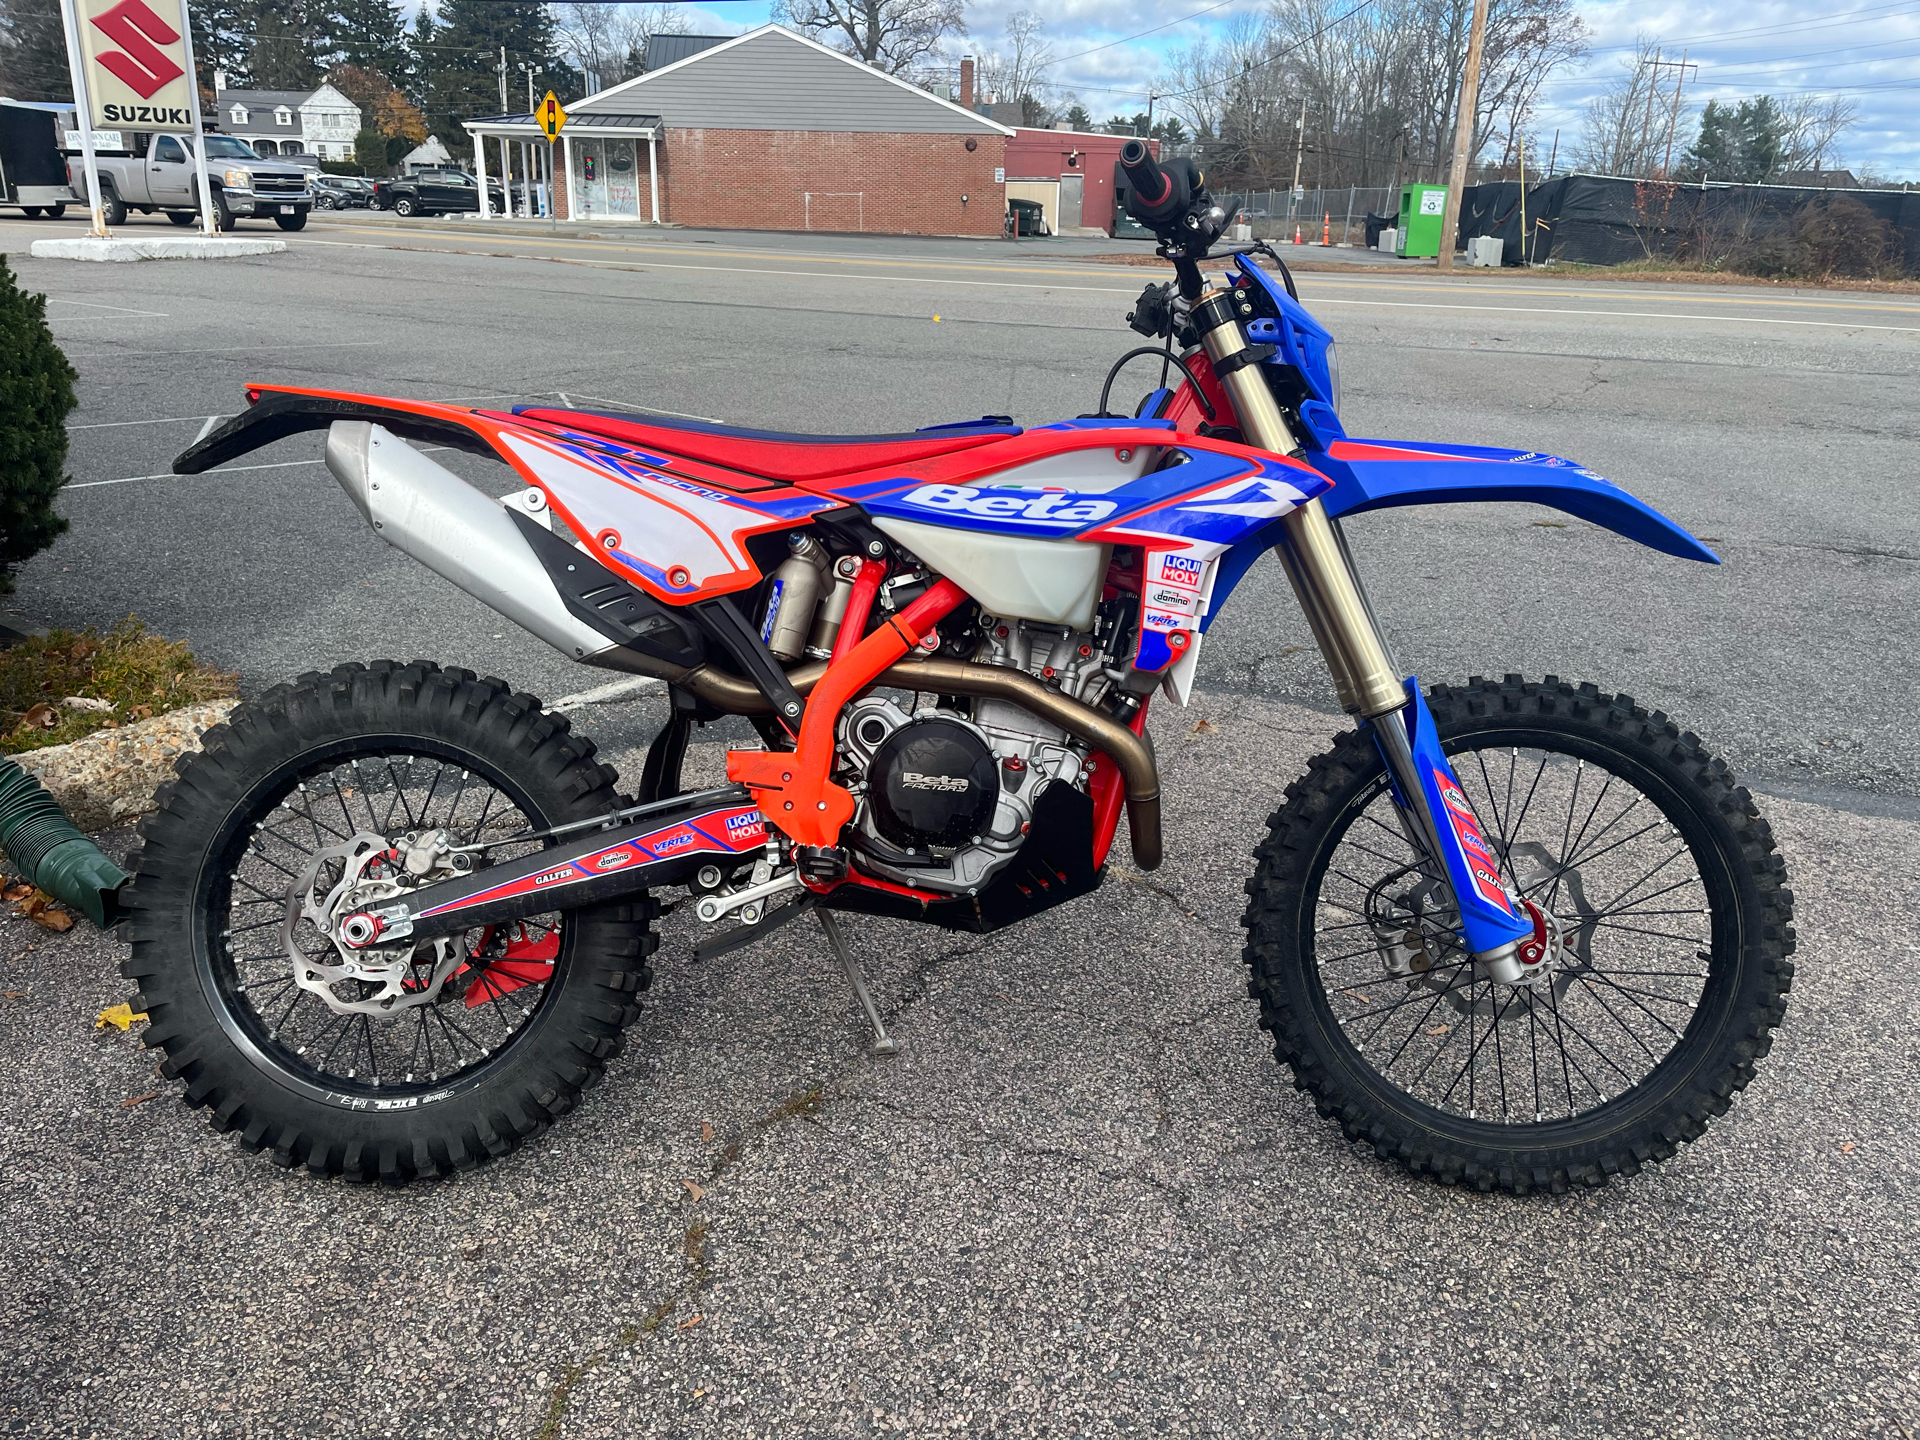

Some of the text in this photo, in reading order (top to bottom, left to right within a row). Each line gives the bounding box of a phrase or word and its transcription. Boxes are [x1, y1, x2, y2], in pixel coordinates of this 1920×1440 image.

[104, 104, 191, 124] SUZUKI
[643, 472, 730, 502] racing
[901, 484, 1118, 521] Beta
[1165, 556, 1200, 573] LIQUI
[1163, 568, 1198, 586] MOLY
[1147, 615, 1180, 627] VERTEX
[902, 772, 969, 787] Beta
[902, 783, 968, 793] FACTORY
[727, 811, 760, 829] LIQUI
[730, 822, 763, 840] MOLY
[535, 868, 573, 885] GALFER
[653, 833, 693, 851] VERTEX
[374, 1097, 418, 1110] EXCEL
